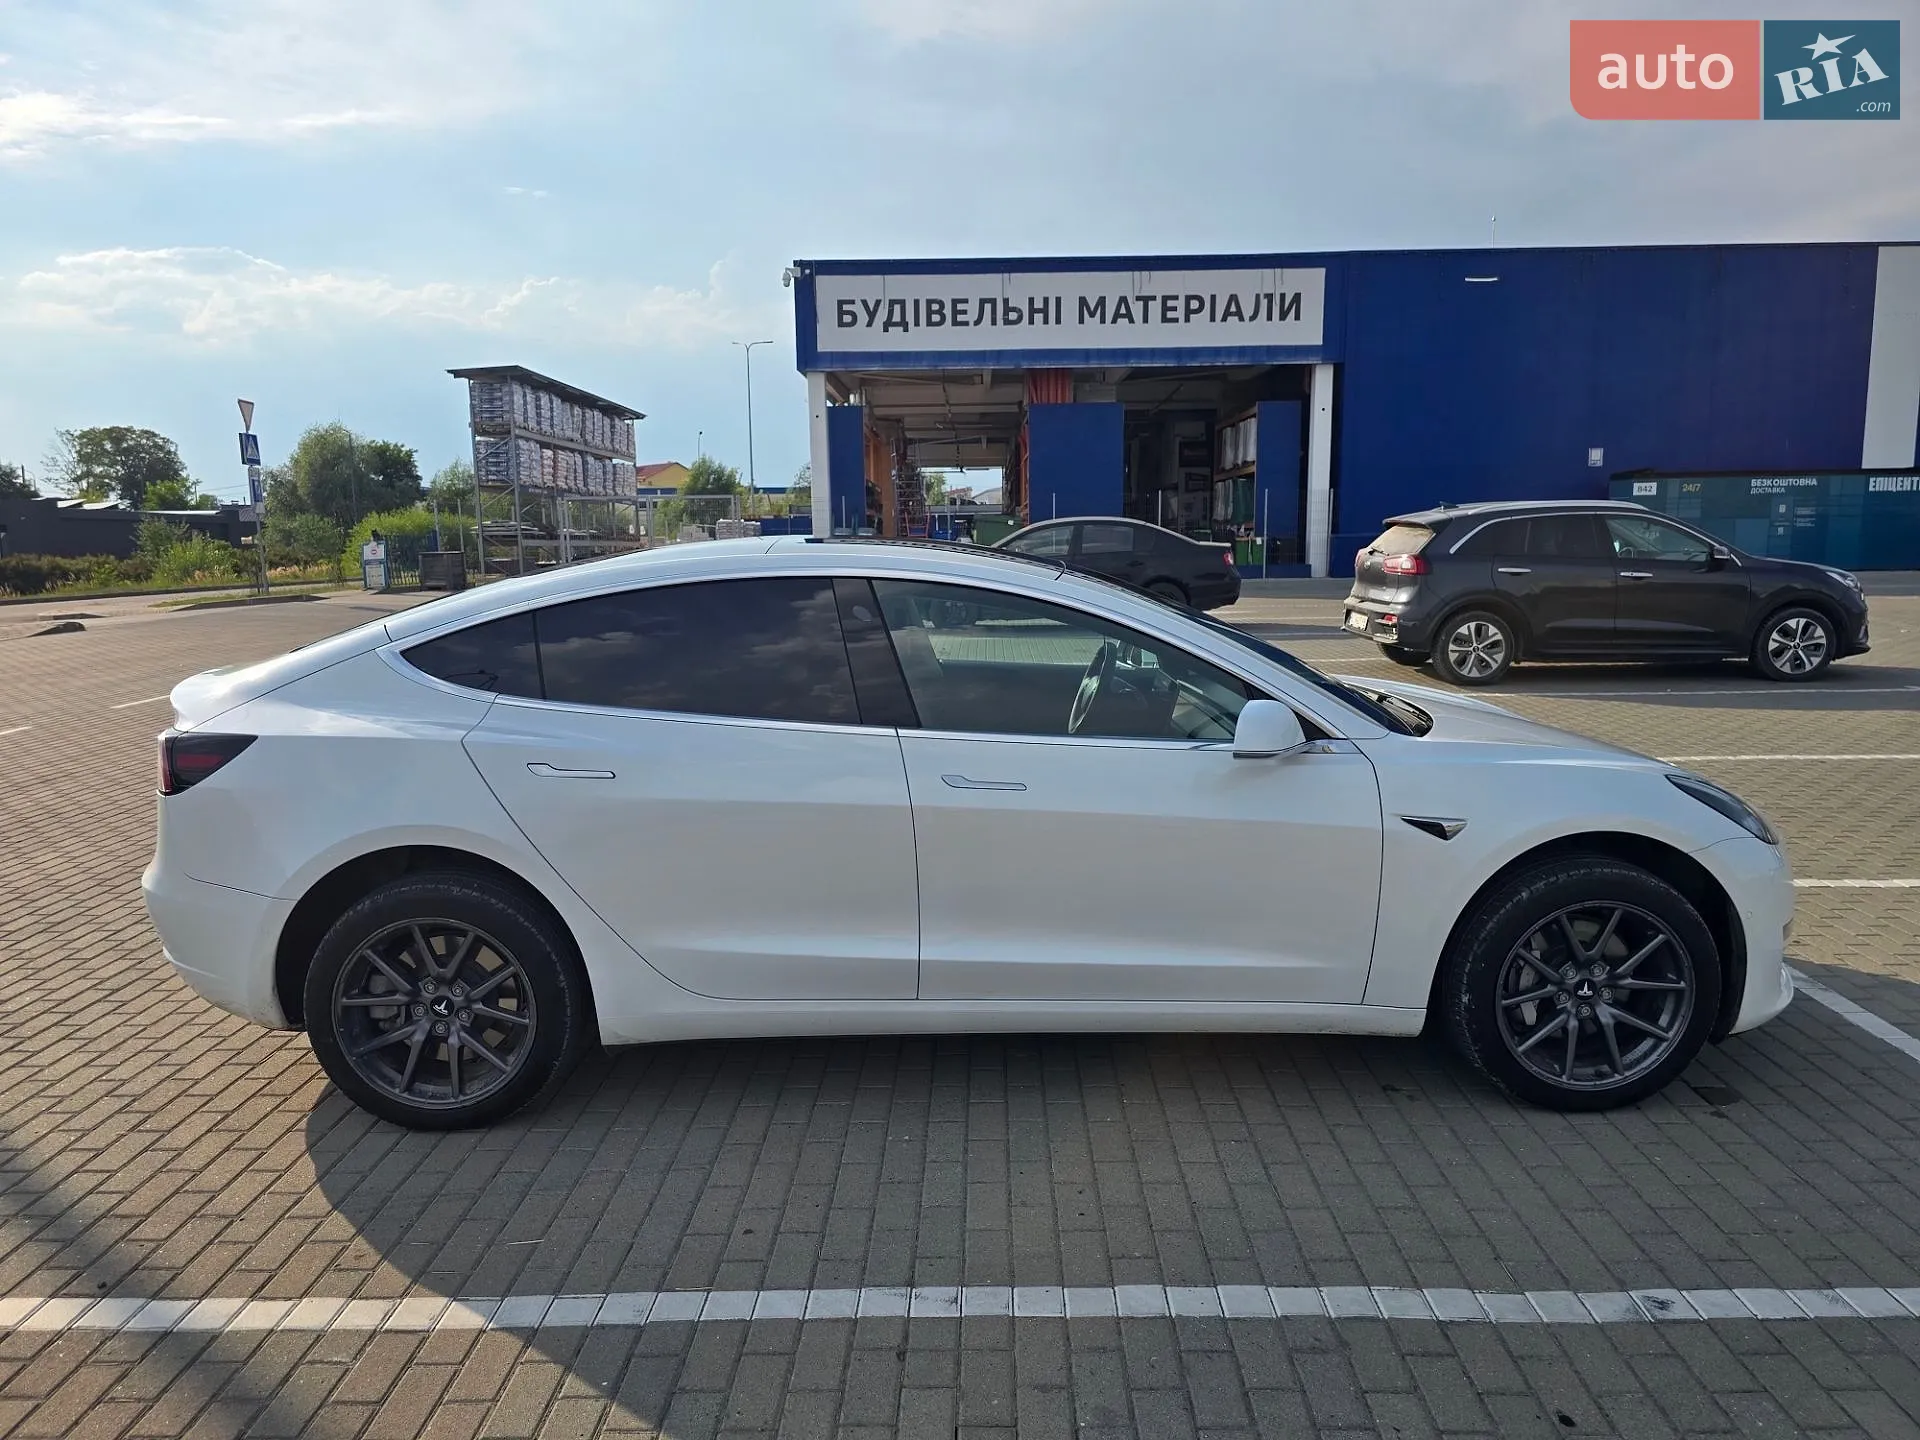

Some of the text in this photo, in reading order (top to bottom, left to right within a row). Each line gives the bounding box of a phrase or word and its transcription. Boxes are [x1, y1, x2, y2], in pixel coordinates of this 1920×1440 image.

[836, 291, 1303, 332] БУДІВЕЛЬНІ МАТЕРІАЛИ
[1750, 478, 1818, 487] БЕЗКОШТОВНА
[1868, 476, 1920, 492] ЕПІЦЕНТ
